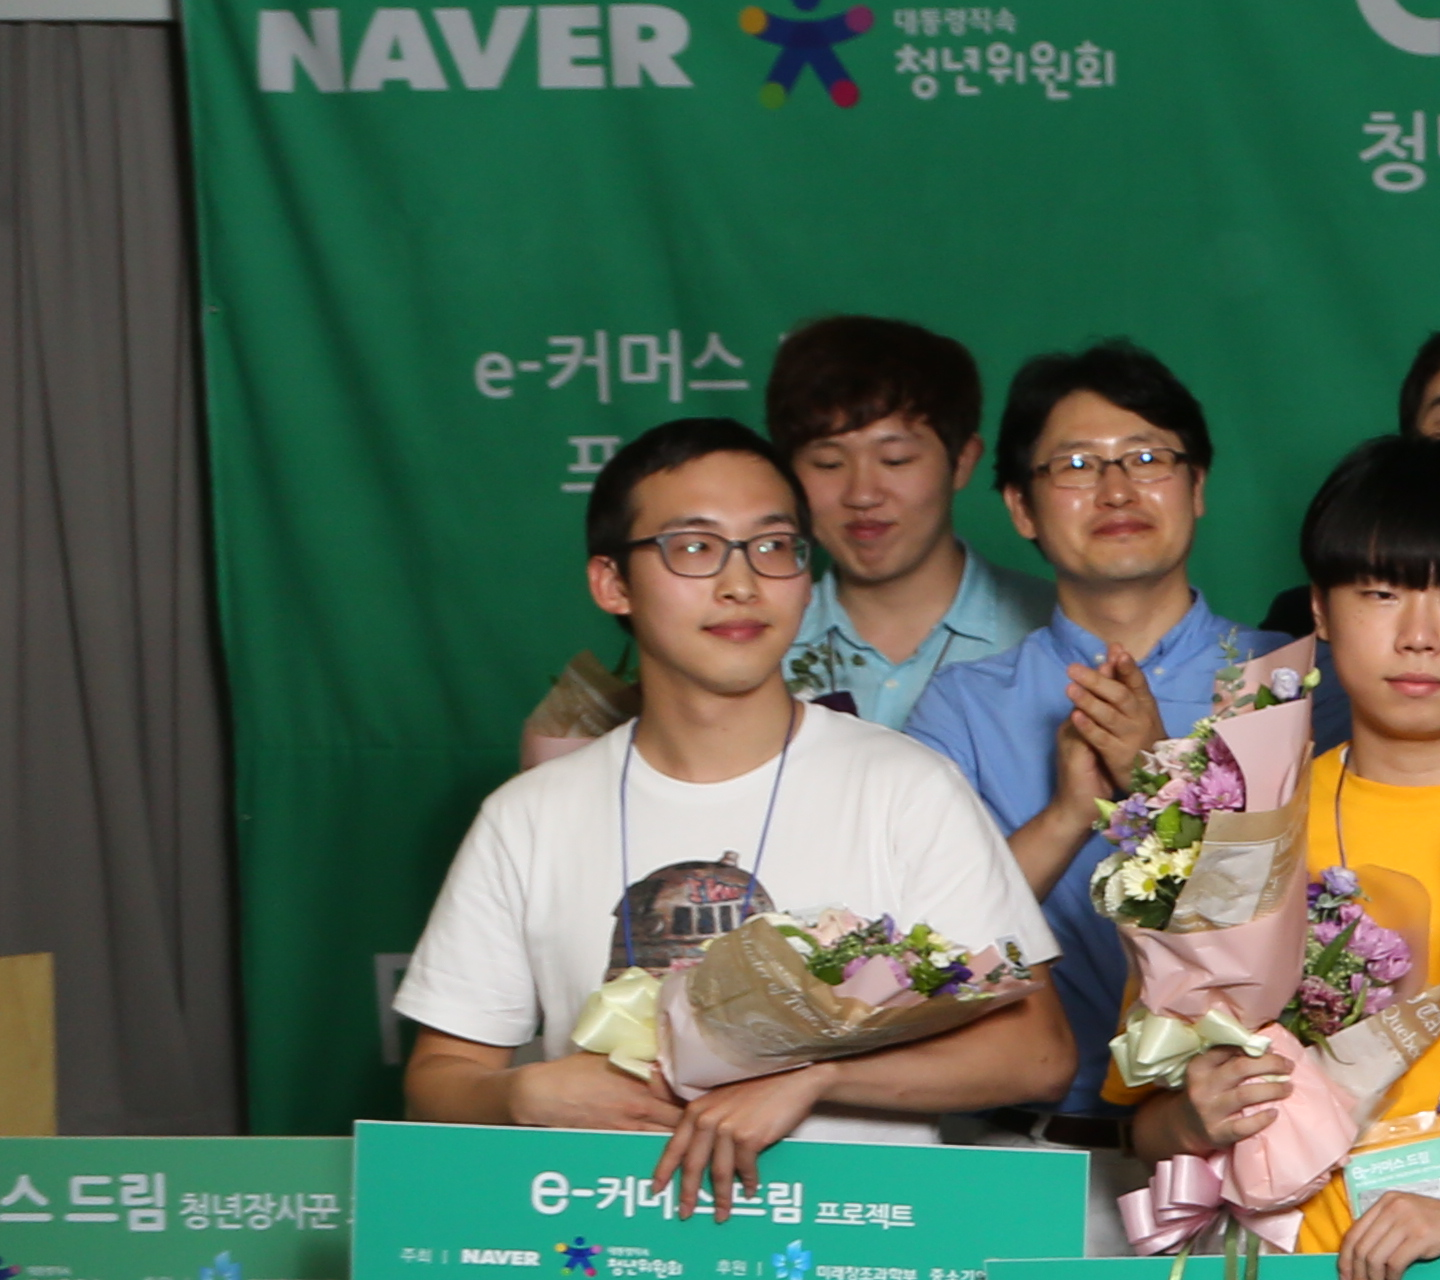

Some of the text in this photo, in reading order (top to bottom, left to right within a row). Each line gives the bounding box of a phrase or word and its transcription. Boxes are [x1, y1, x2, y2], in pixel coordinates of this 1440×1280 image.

[255, 4, 693, 93] NAVER
[894, 41, 1117, 99] 청년위원회
[474, 330, 749, 404] e-커머스
[65, 1172, 167, 1232] 드림
[179, 1192, 341, 1231] 청년장사꾼
[730, 1182, 803, 1224] 드림
[814, 1201, 916, 1230] 프로젝트
[460, 1248, 541, 1266] NAVER
